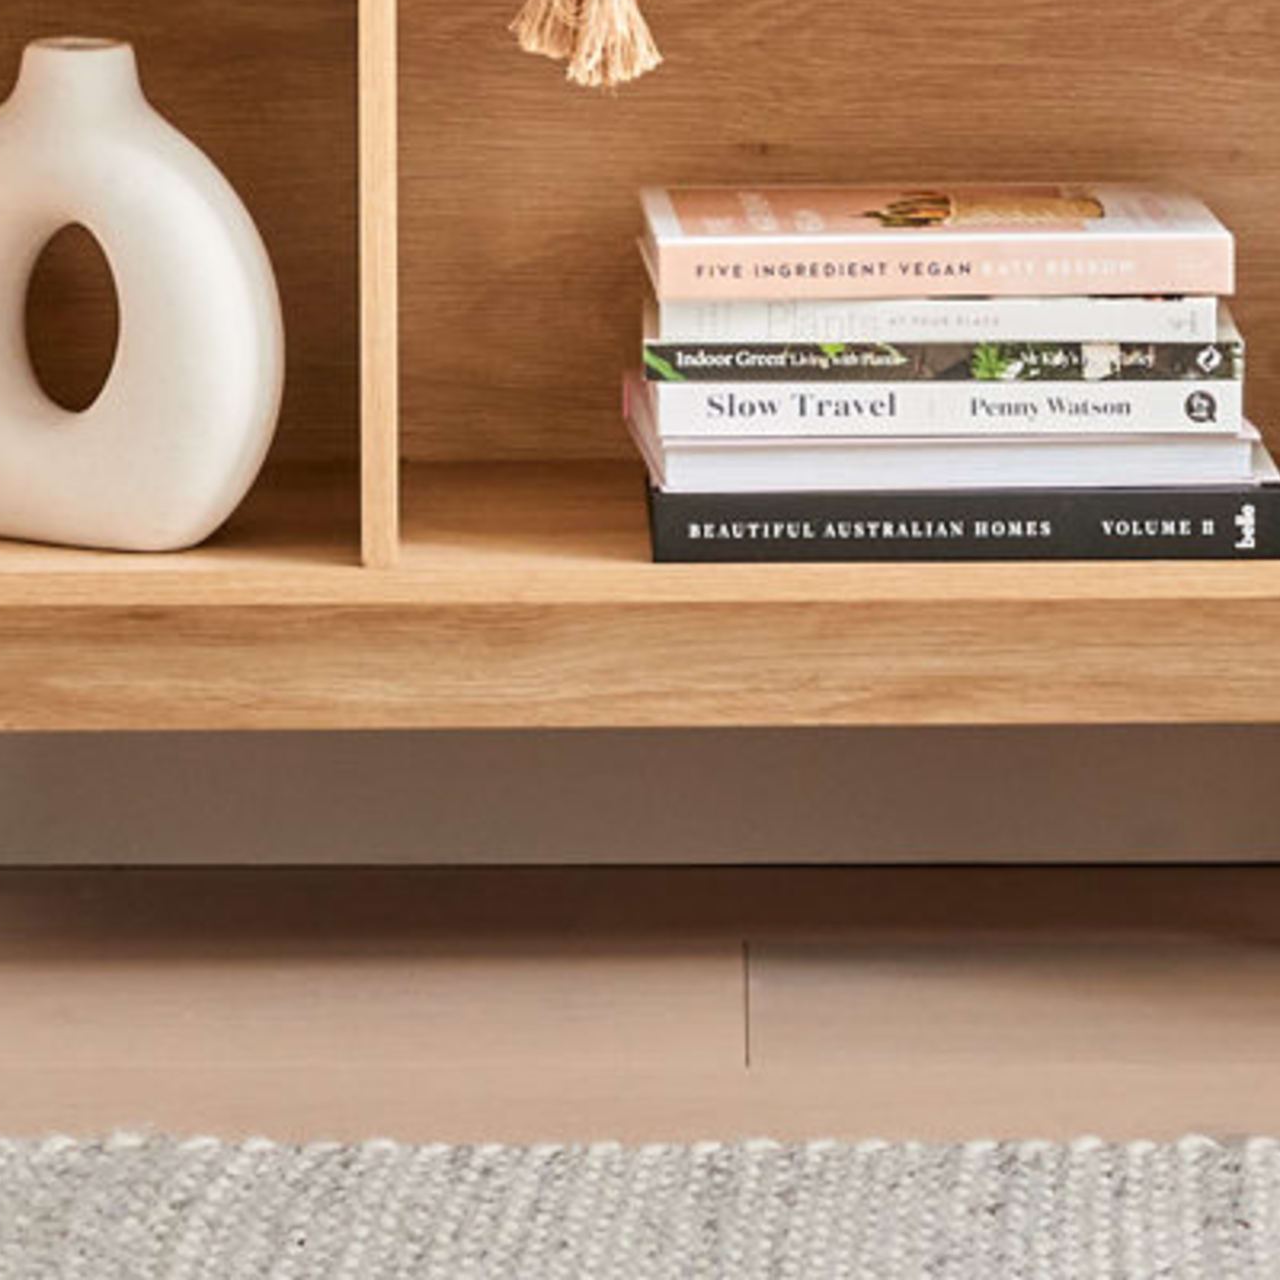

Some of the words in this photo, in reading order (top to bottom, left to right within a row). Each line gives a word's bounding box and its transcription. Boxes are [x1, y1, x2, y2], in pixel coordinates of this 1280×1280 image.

[695, 264, 743, 278] FIVE
[754, 262, 888, 278] INGREDIENT
[898, 261, 972, 276] VEGAN
[676, 349, 731, 366] Indoor
[706, 393, 780, 417] Slow
[791, 392, 897, 417] Travel
[970, 397, 1038, 421] Penny
[1045, 397, 1132, 416] Watson
[688, 522, 816, 539] BEAUTIFUL
[822, 521, 965, 538] AUSTRALIAN
[974, 520, 1052, 537] HOMES
[1101, 520, 1192, 536] VOLUME
[1201, 520, 1215, 536] II
